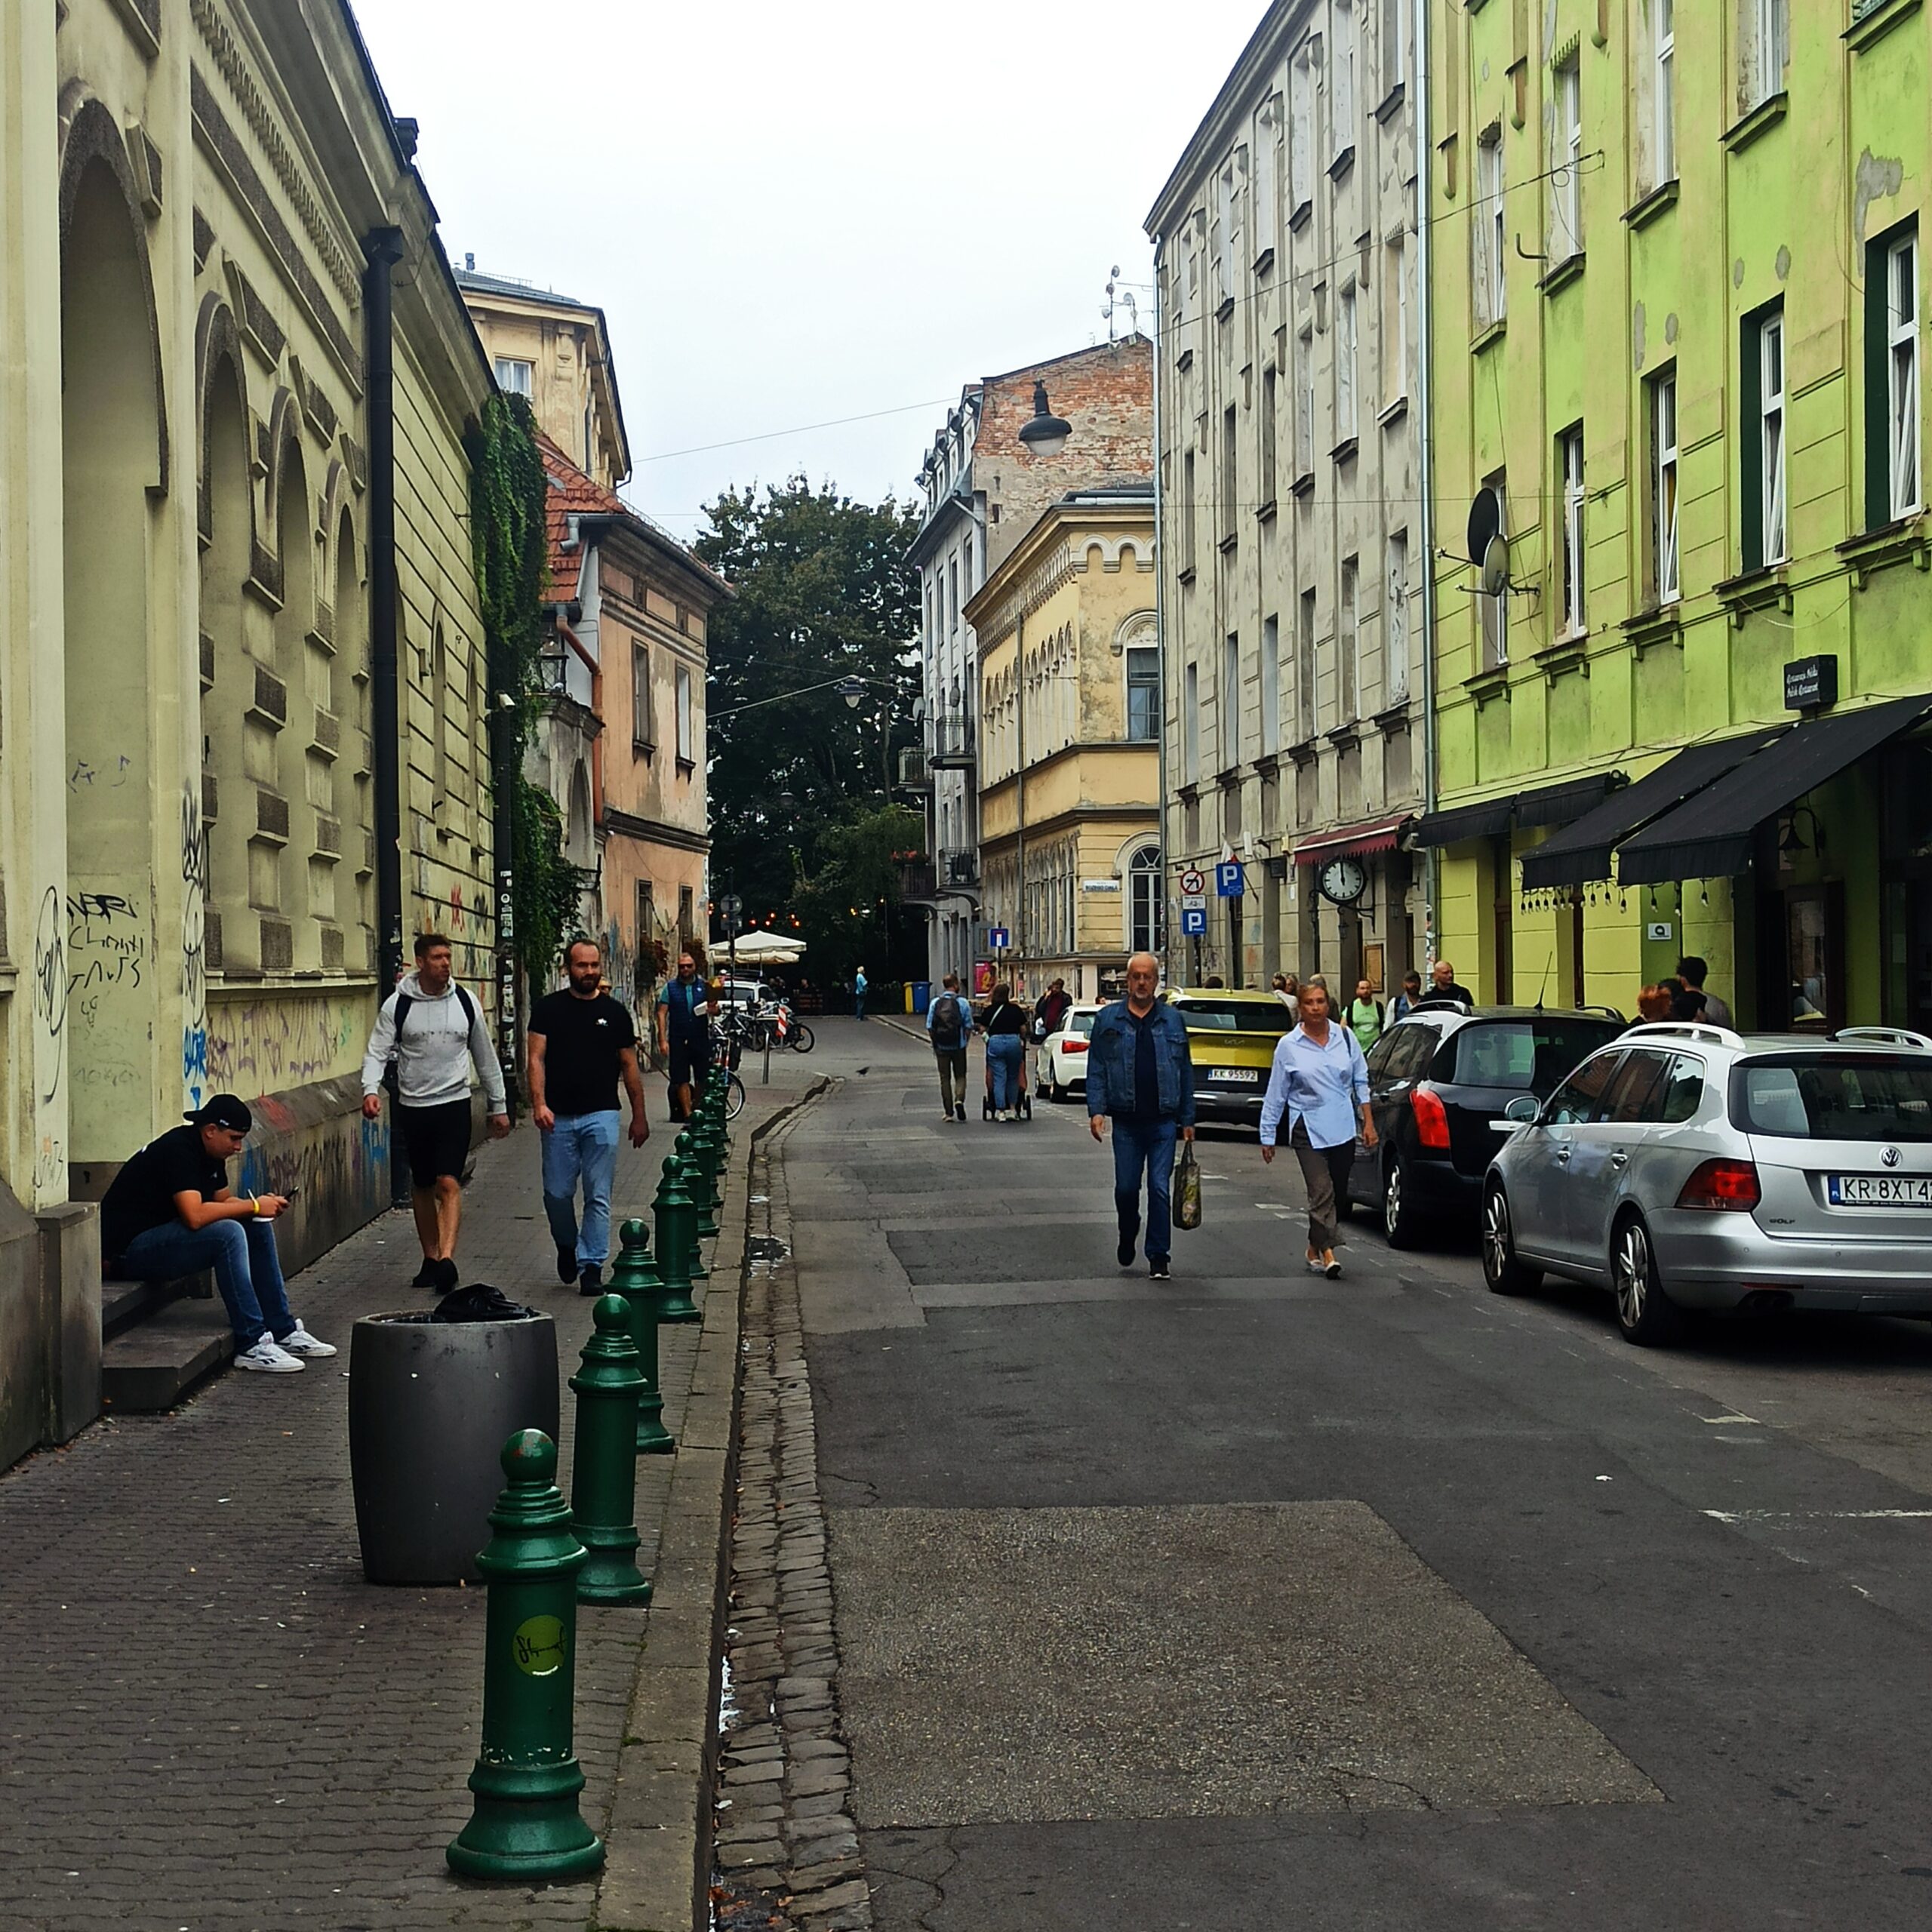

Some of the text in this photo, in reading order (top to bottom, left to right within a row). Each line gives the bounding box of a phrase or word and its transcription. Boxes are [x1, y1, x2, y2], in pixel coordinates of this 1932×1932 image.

[1223, 866, 1238, 886] P
[1188, 912, 1201, 931] P
[1214, 1070, 1226, 1078] KK
[1844, 1179, 1932, 1200] KR 8XT4
